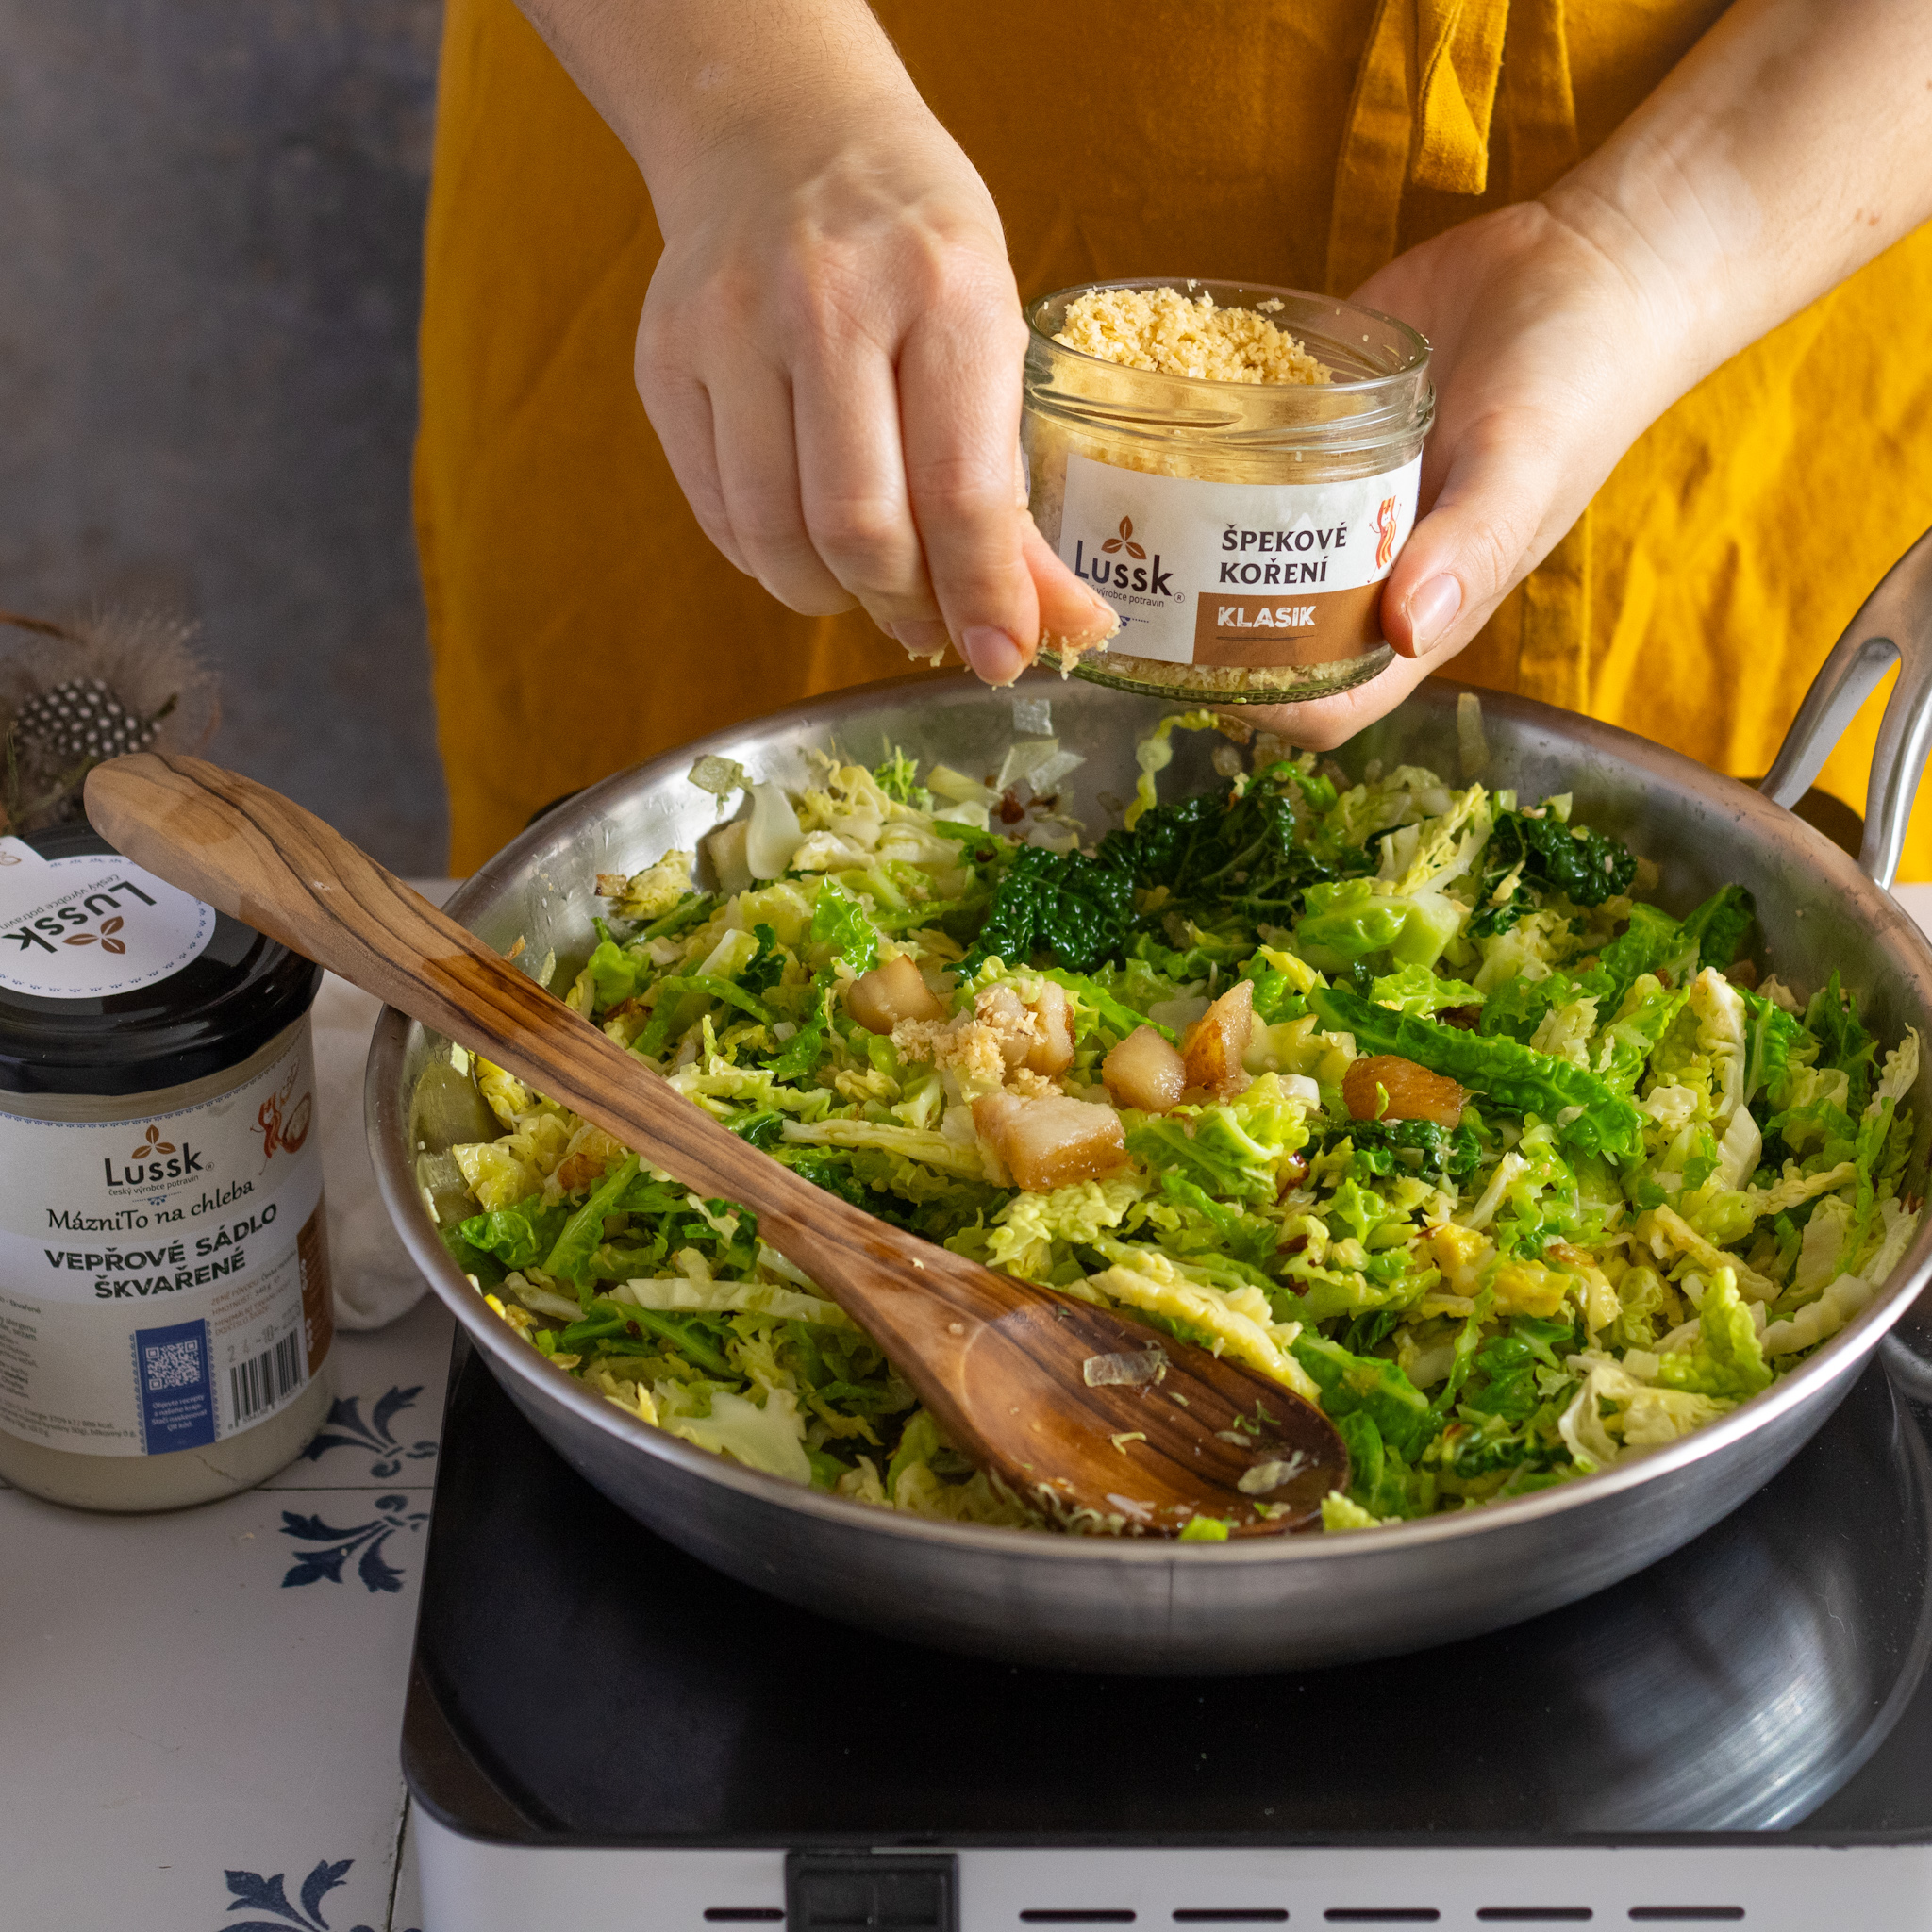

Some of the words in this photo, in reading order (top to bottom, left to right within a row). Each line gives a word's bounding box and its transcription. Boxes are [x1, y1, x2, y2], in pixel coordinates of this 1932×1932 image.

[1222, 521, 1348, 552] ŠPEKOVÉ
[1075, 539, 1174, 596] Lussk
[1219, 556, 1328, 585] KOŘENÍ
[1128, 595, 1165, 608] potravin
[1217, 605, 1317, 629] KLASIK
[1, 880, 157, 954] Lussk
[46, 889, 88, 910] výrobce
[104, 1142, 204, 1187] Lussk
[46, 1208, 150, 1232] MázniTo
[156, 1207, 186, 1225] na
[191, 1177, 256, 1218] chleba
[108, 1187, 132, 1197] český
[133, 1183, 165, 1195] výrobce
[167, 1174, 199, 1191] potravin
[44, 1239, 187, 1273] VEPŘOVÉ
[194, 1202, 278, 1258] SÁDLO
[94, 1248, 247, 1299] ŠKVAŘENÉ
